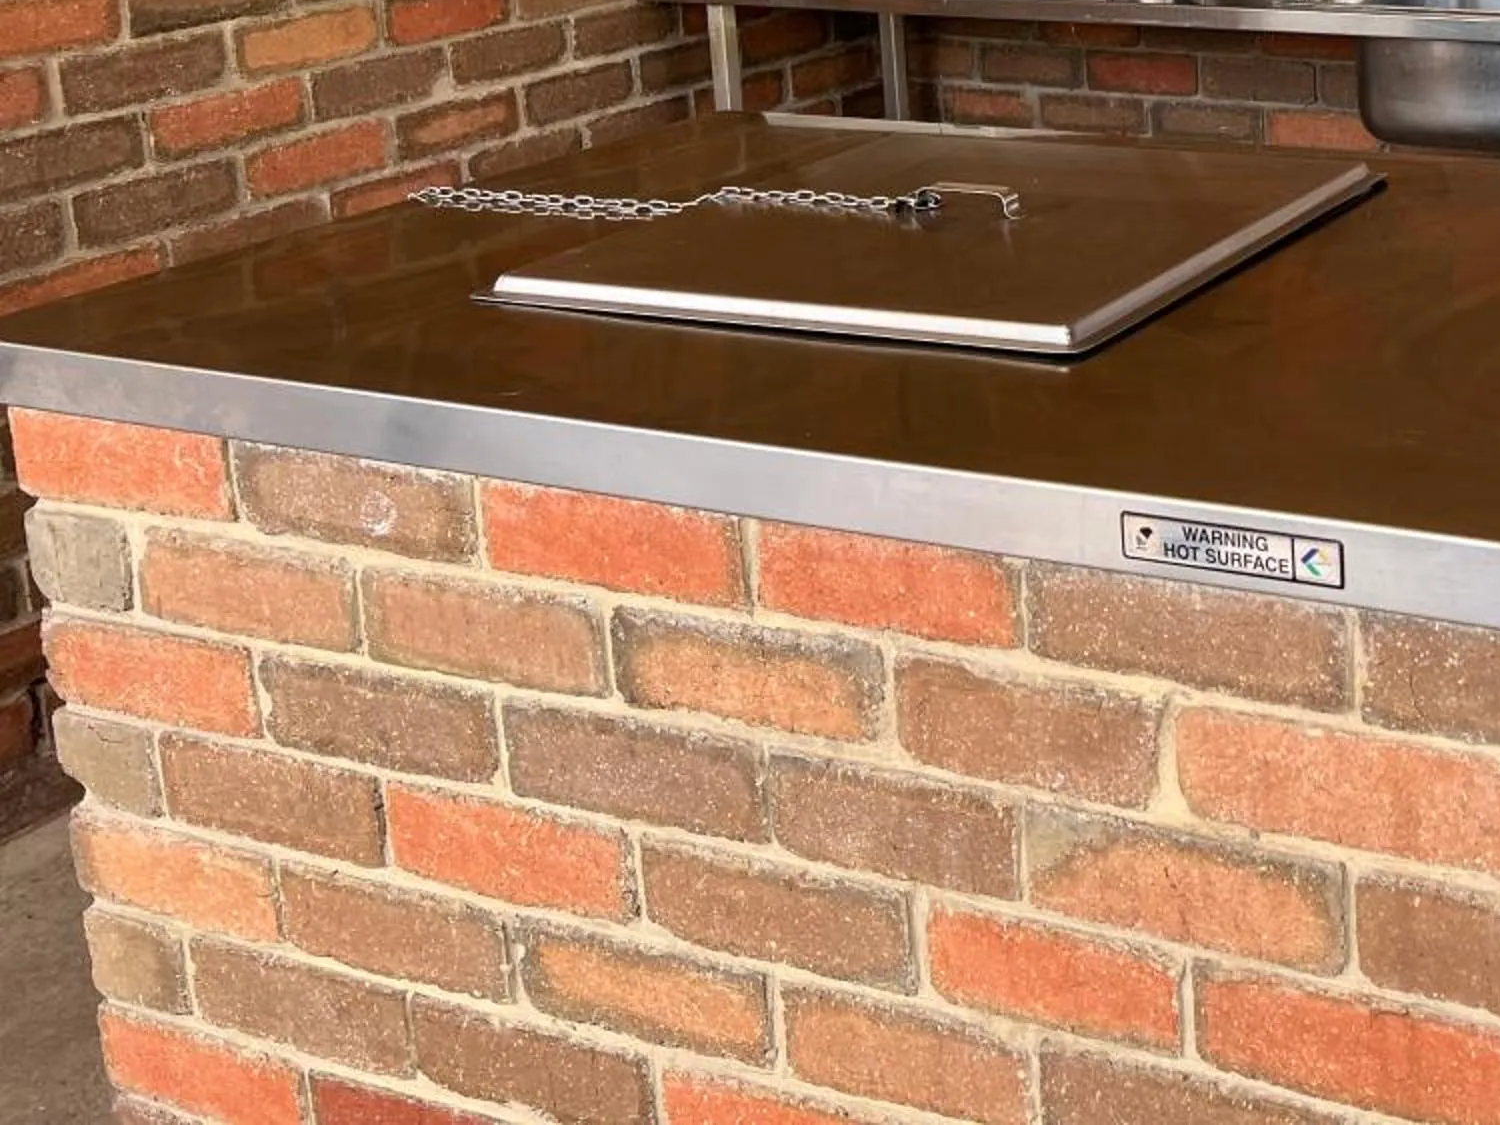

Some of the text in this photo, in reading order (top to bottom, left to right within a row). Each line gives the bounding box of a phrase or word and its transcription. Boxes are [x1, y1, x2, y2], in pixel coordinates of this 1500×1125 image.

[1181, 526, 1269, 552] WARNING
[1163, 542, 1290, 575] HOT SURFACE
